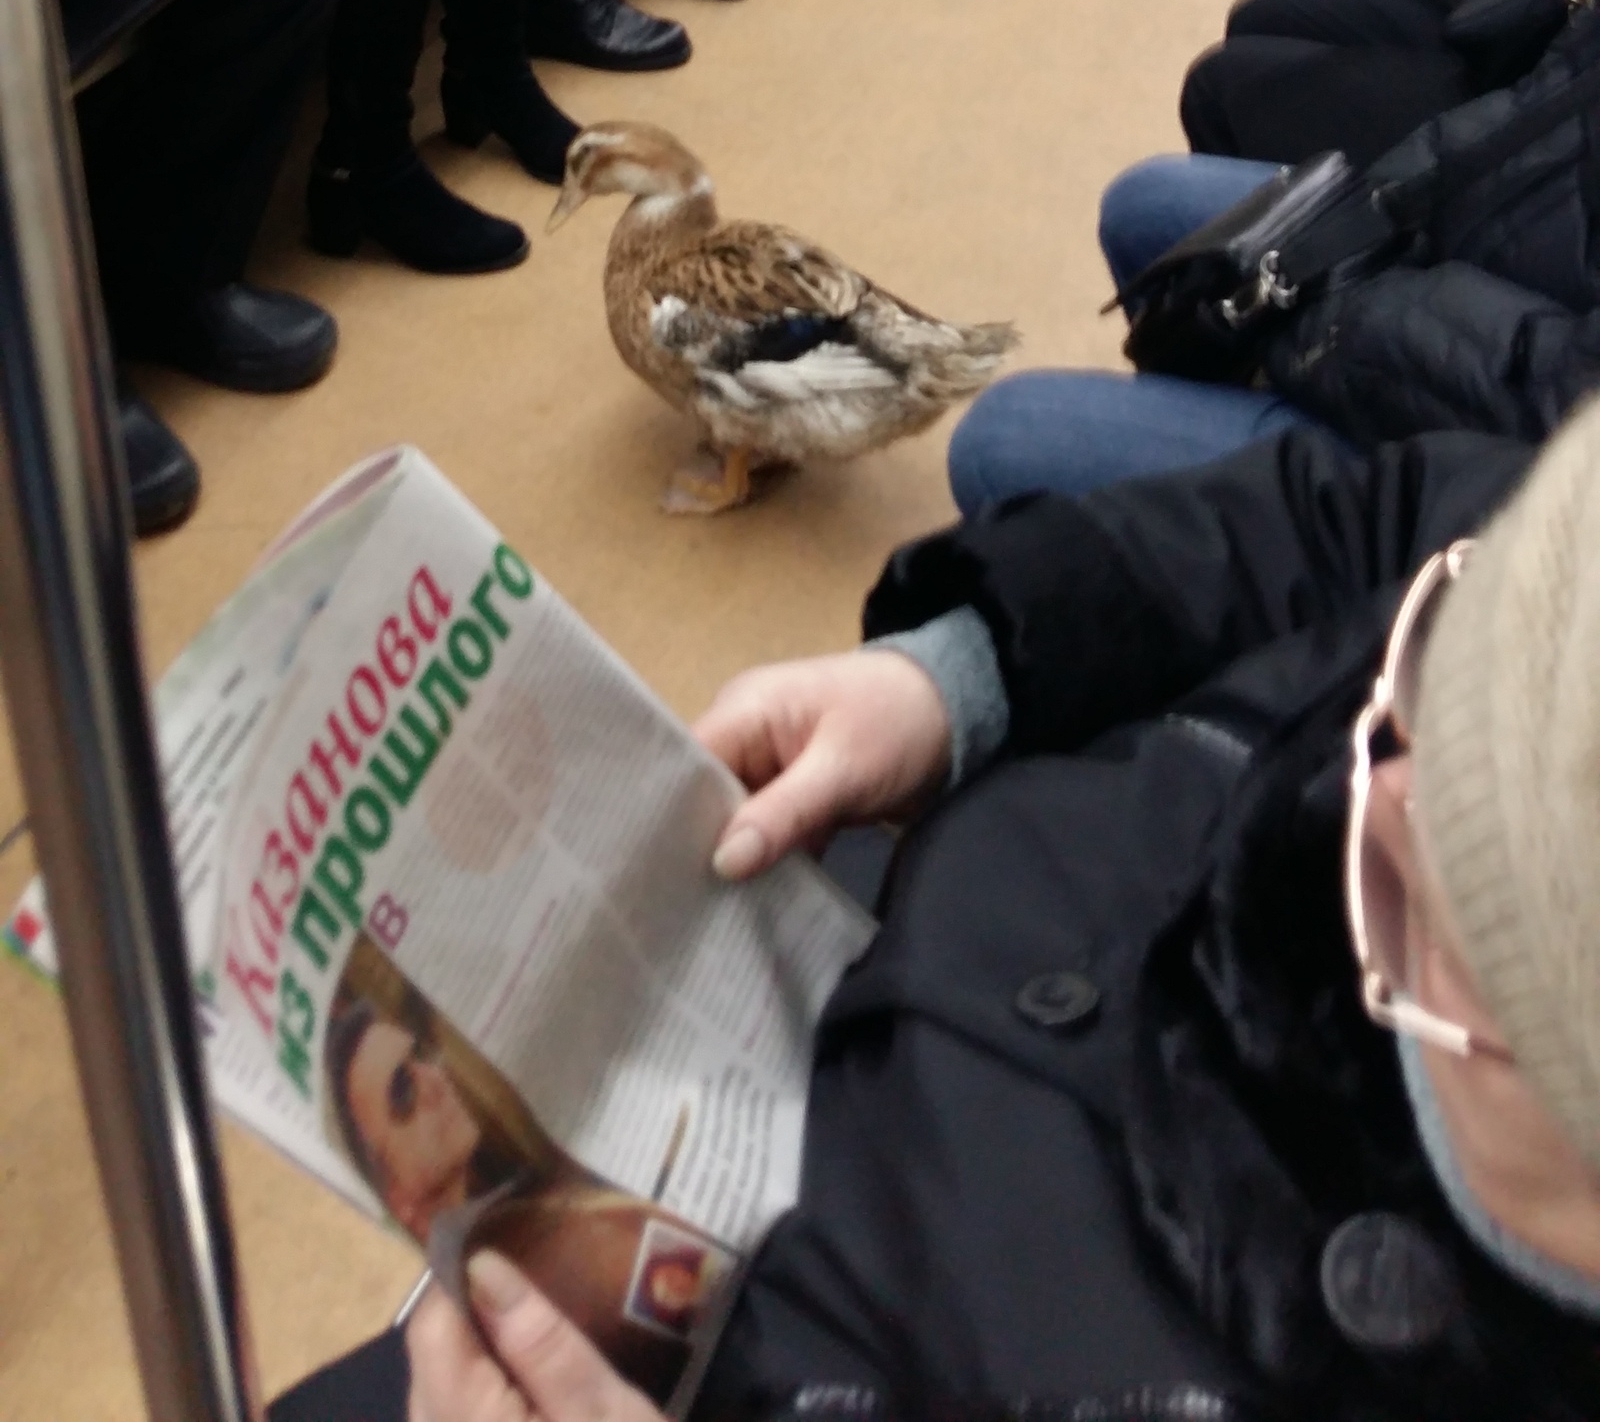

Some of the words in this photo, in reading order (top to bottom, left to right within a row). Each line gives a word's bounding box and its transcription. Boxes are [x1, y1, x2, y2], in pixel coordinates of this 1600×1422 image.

[224, 564, 452, 1036] Казанова
[291, 543, 534, 971] прошлого
[368, 892, 410, 951] В
